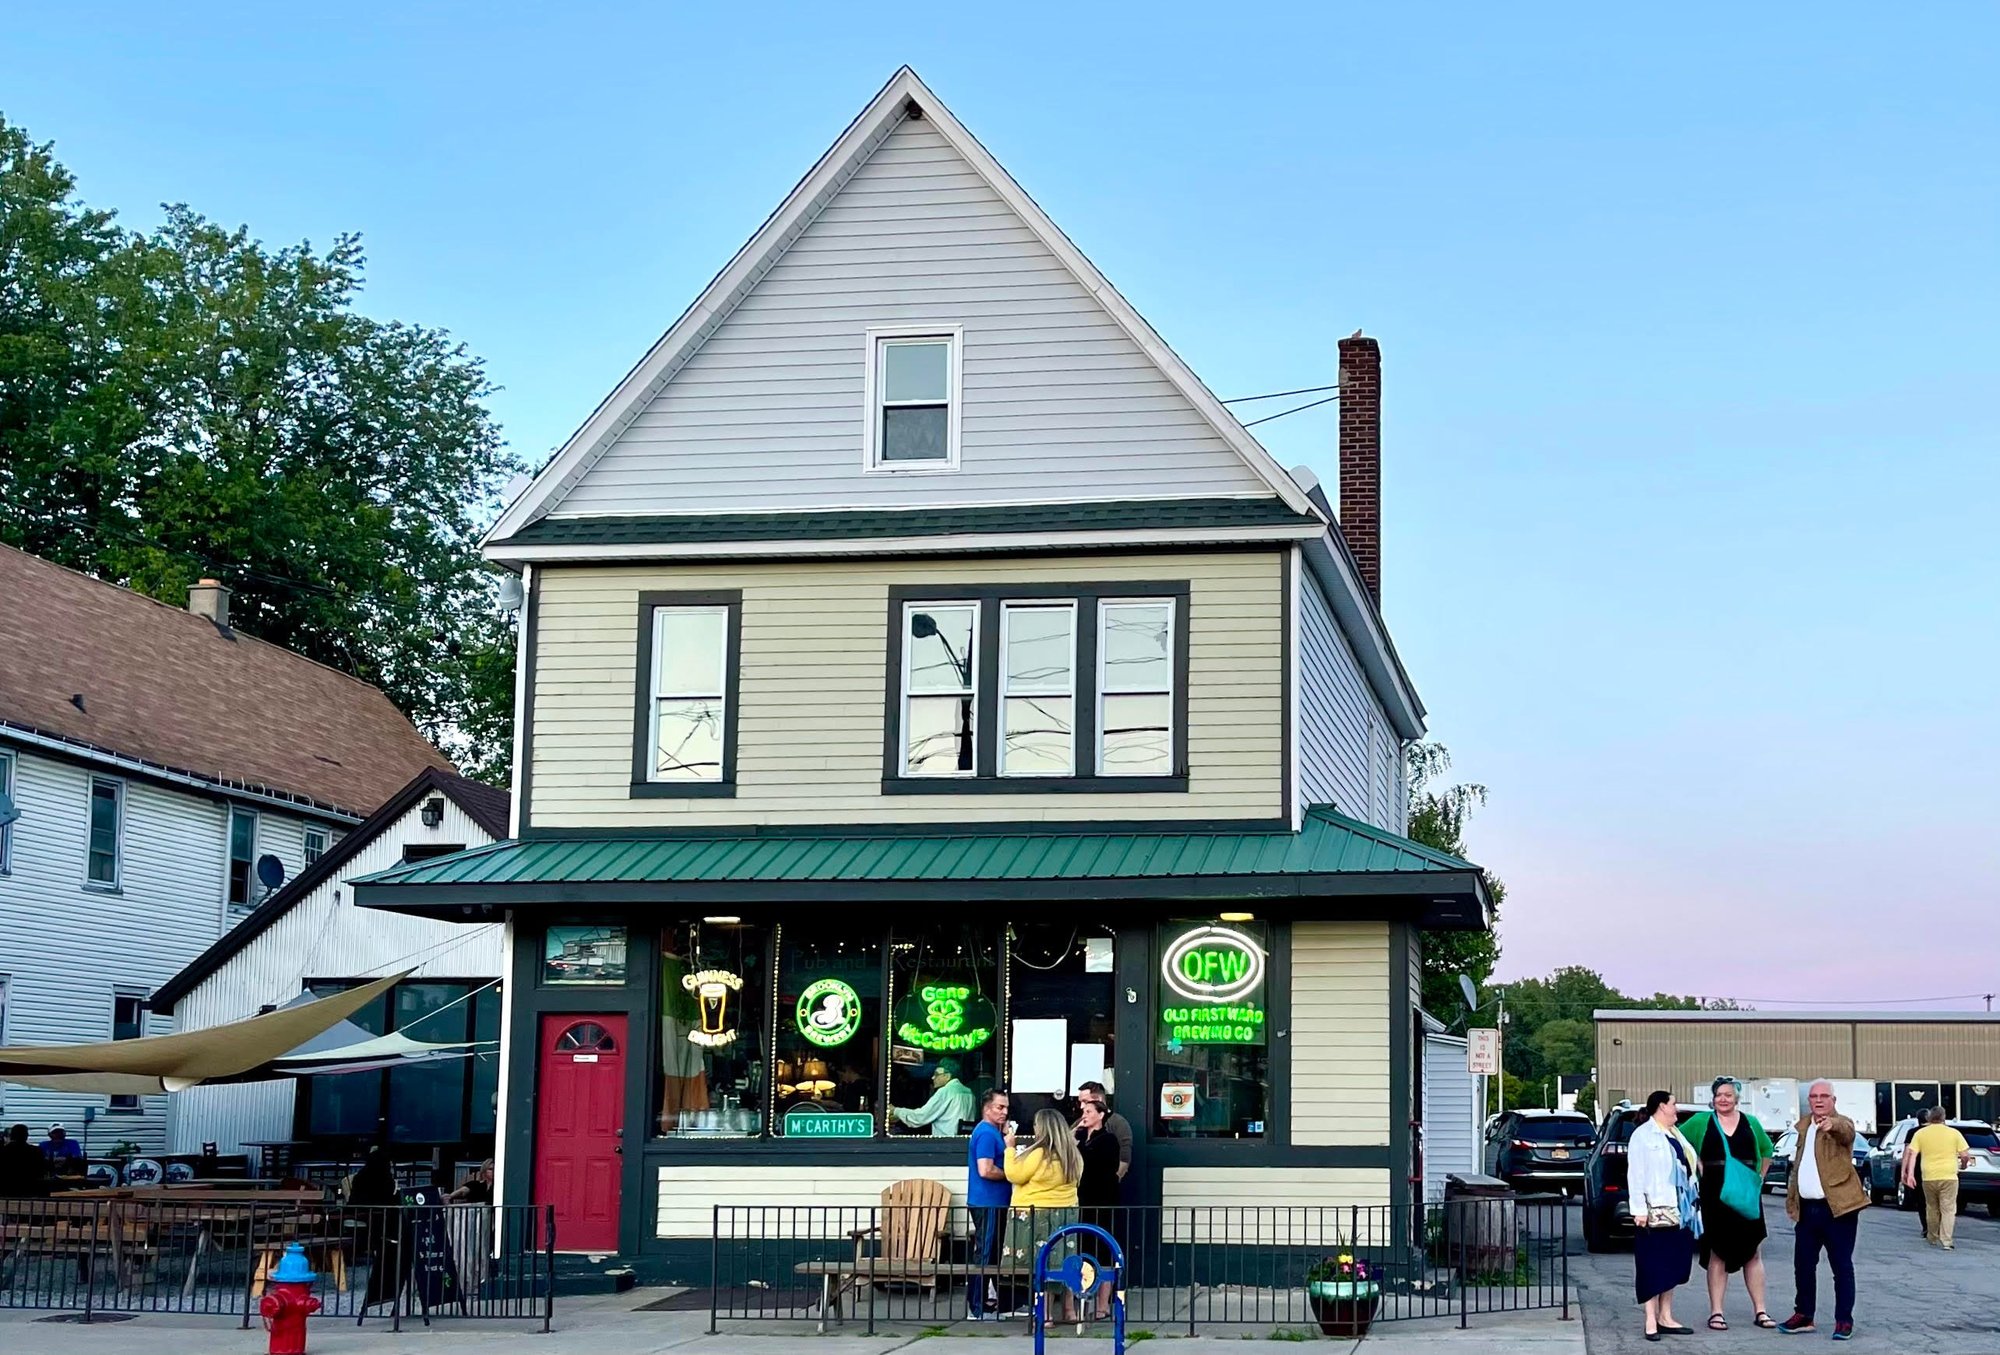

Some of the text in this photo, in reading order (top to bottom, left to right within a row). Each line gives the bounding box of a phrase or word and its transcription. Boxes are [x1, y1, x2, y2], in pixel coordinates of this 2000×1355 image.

[1183, 950, 1247, 982] OFW
[681, 969, 744, 991] GUINNESS
[921, 986, 970, 1002] Gene
[1163, 1006, 1264, 1023] OLD FIRST WARD
[898, 1022, 990, 1050] McCarthy's
[1173, 1025, 1254, 1041] BREWING CO
